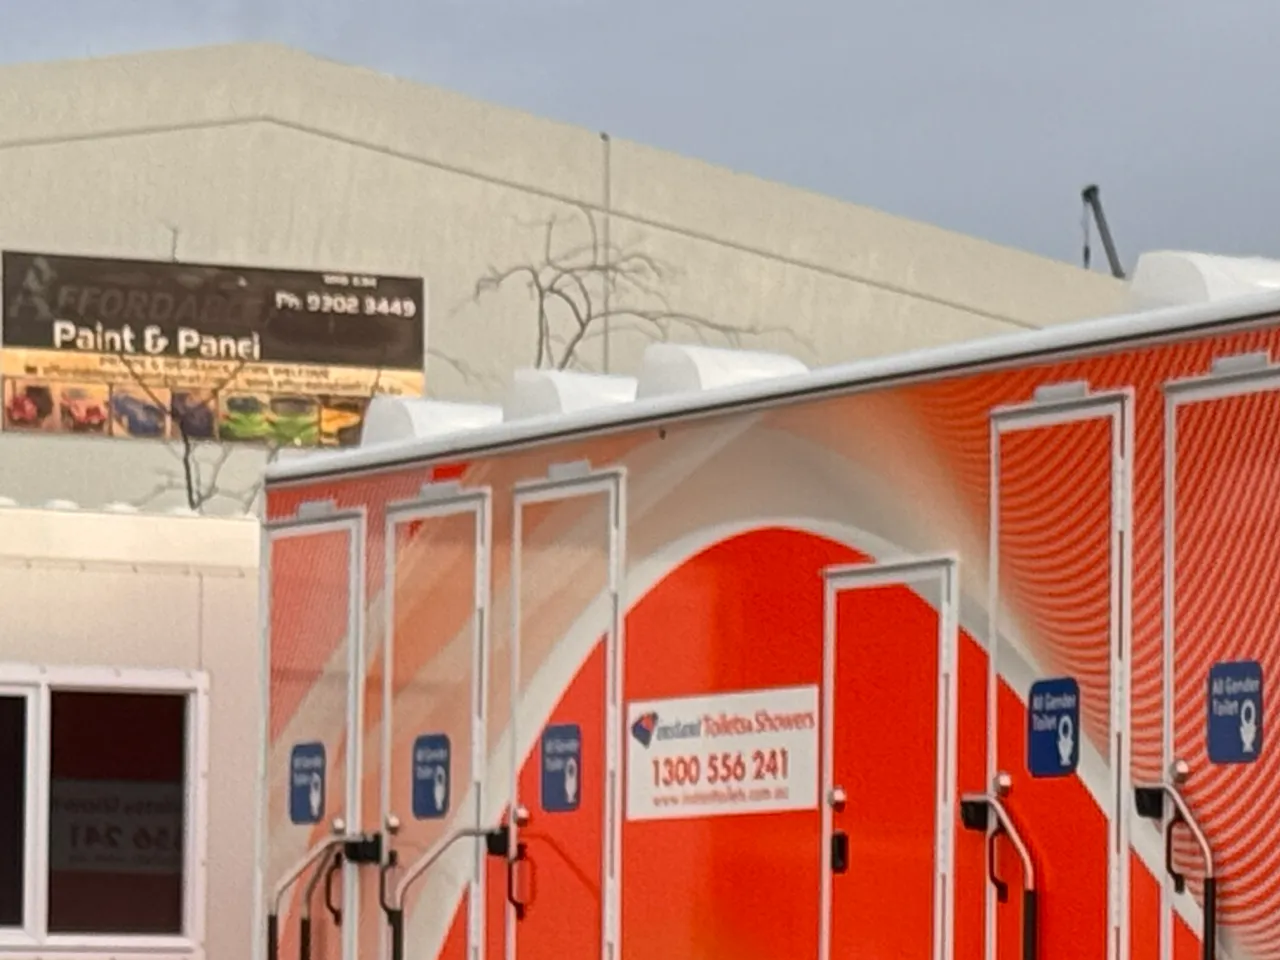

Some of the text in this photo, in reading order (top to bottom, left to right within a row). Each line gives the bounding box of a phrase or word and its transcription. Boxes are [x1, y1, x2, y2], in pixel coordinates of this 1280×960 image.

[53, 319, 260, 361] Paint & Panel
[652, 747, 789, 787] 1300 556 241
